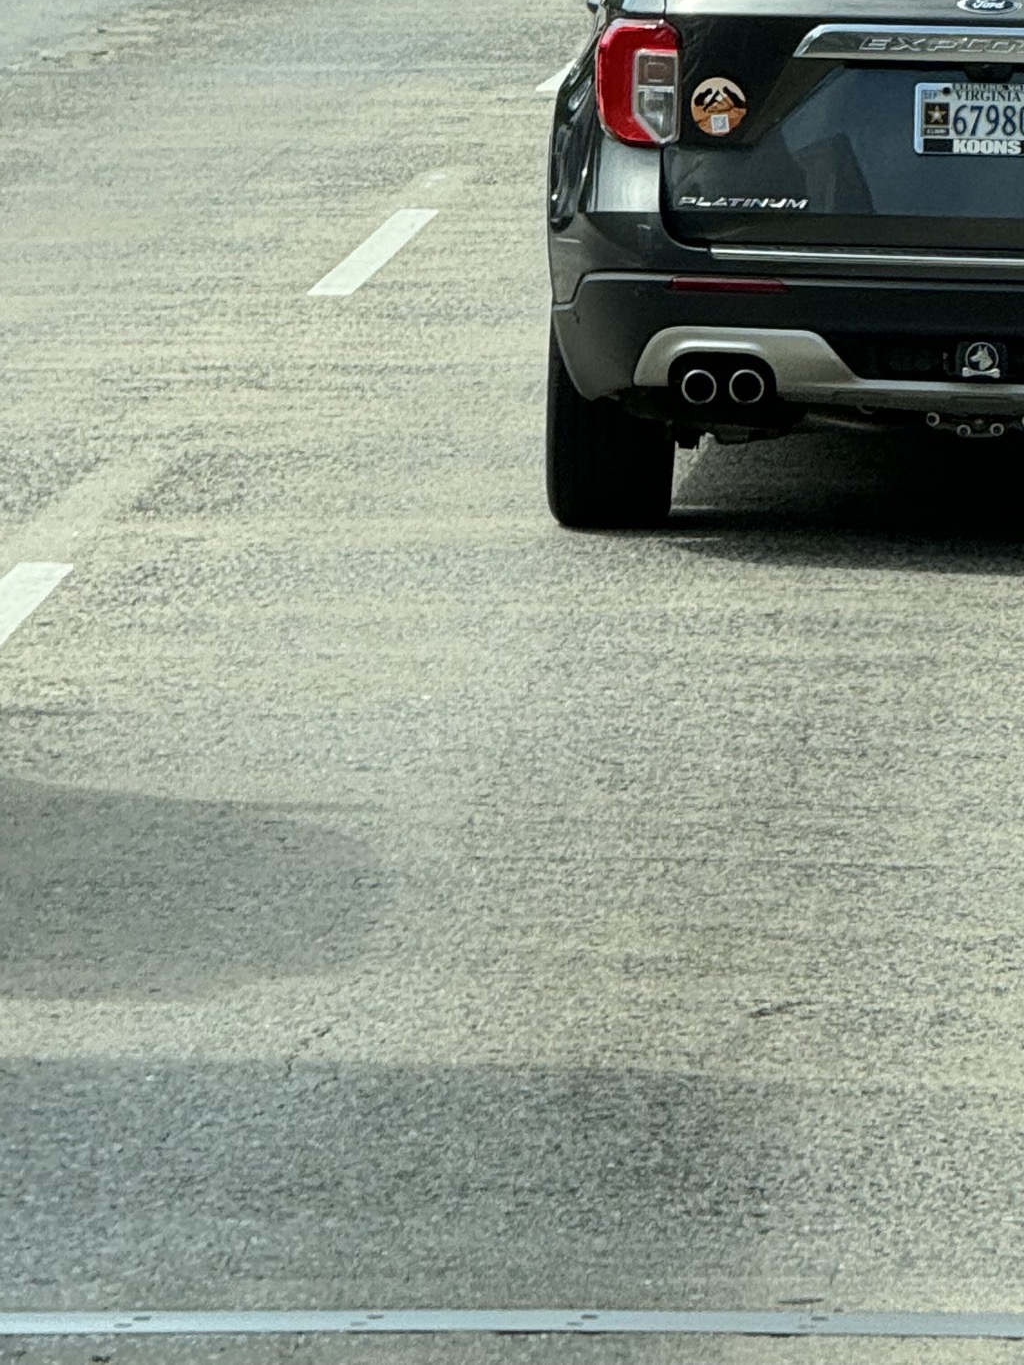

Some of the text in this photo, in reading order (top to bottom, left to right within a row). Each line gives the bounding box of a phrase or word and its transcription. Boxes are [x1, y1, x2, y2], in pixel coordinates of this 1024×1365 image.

[955, 90, 1022, 103] VIRGINIA
[951, 138, 1022, 155] KOONS
[678, 196, 809, 210] PLATINUM
